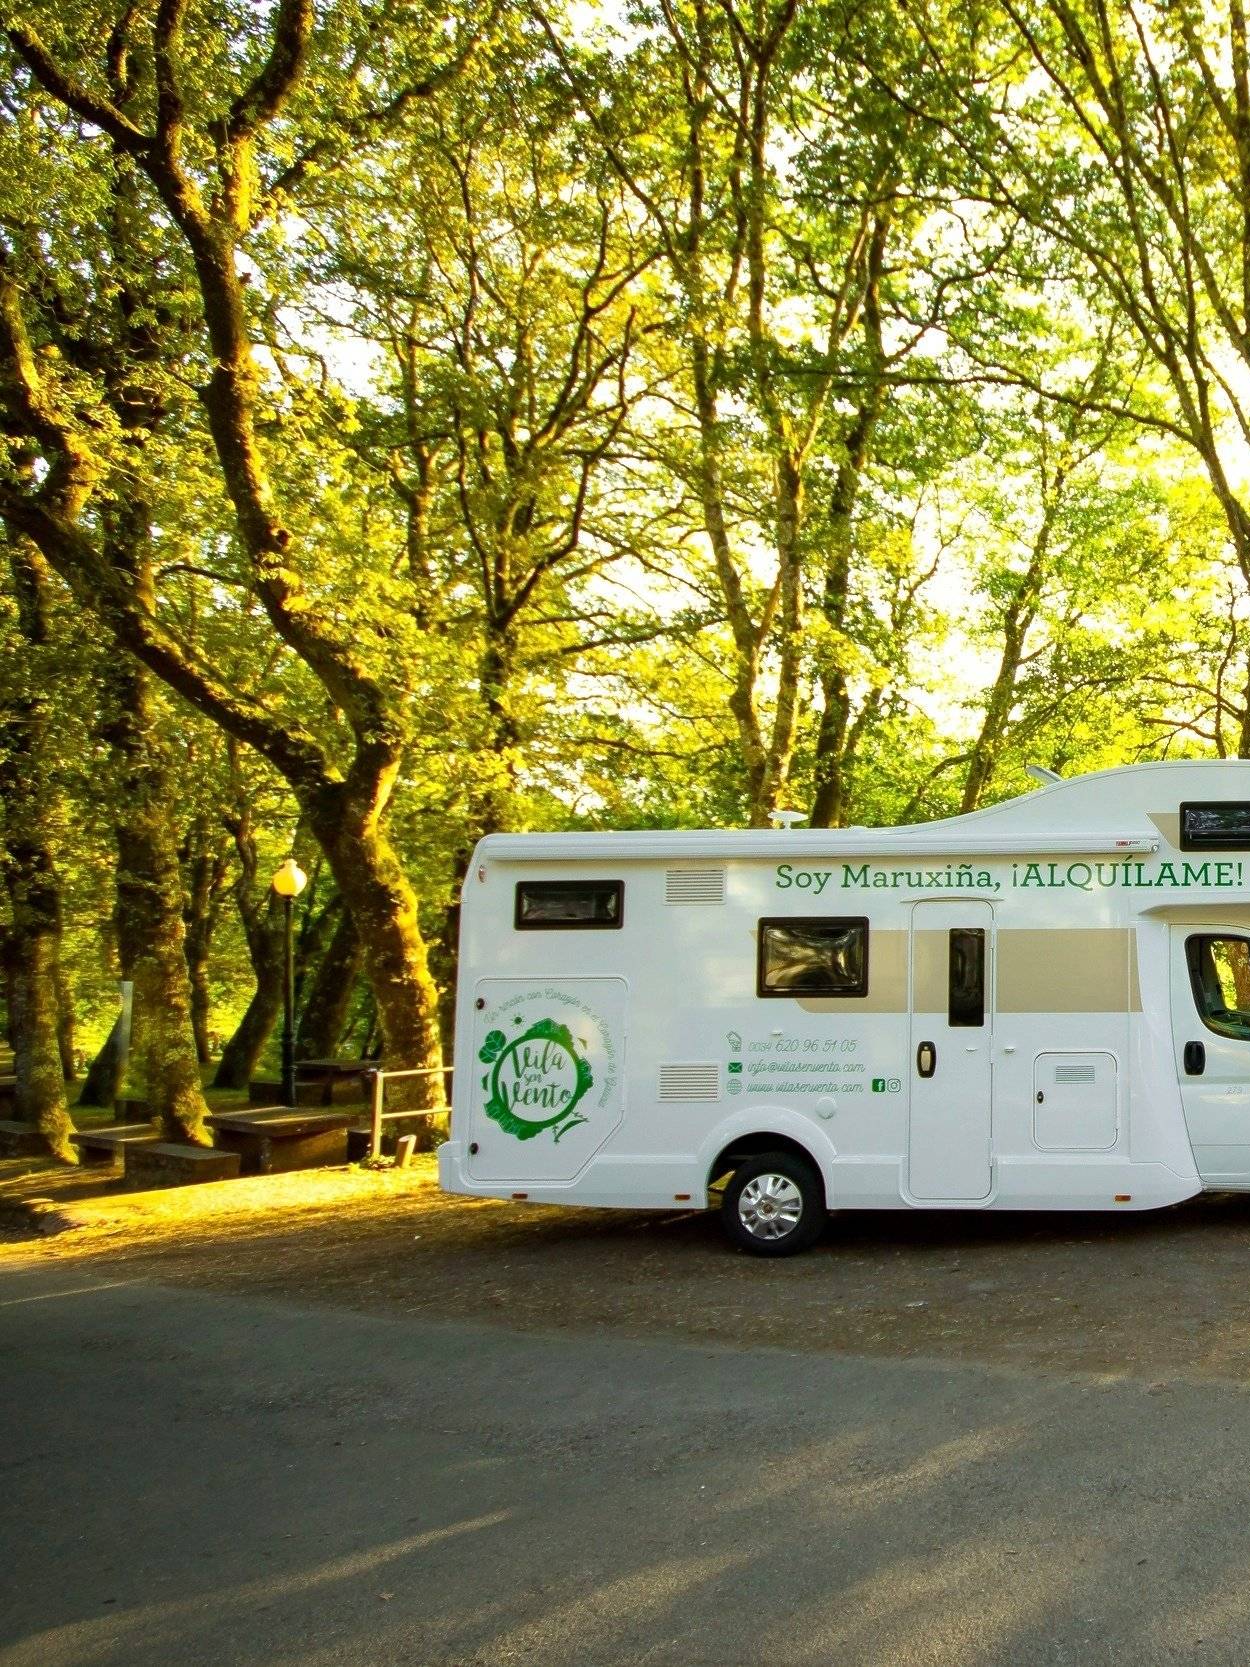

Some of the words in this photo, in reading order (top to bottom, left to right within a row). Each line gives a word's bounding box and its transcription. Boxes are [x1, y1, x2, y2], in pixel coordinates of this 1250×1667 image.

[775, 864, 832, 895] Soy
[841, 863, 1001, 892] Maruxiña,
[1012, 854, 1243, 892] ¡ALQUÍLAME!
[512, 1040, 566, 1079] Vila
[775, 1039, 799, 1052] 620
[802, 1039, 820, 1052] 96
[840, 1039, 858, 1052] 05
[524, 1072, 543, 1086] sen
[501, 1081, 575, 1112] Vento
